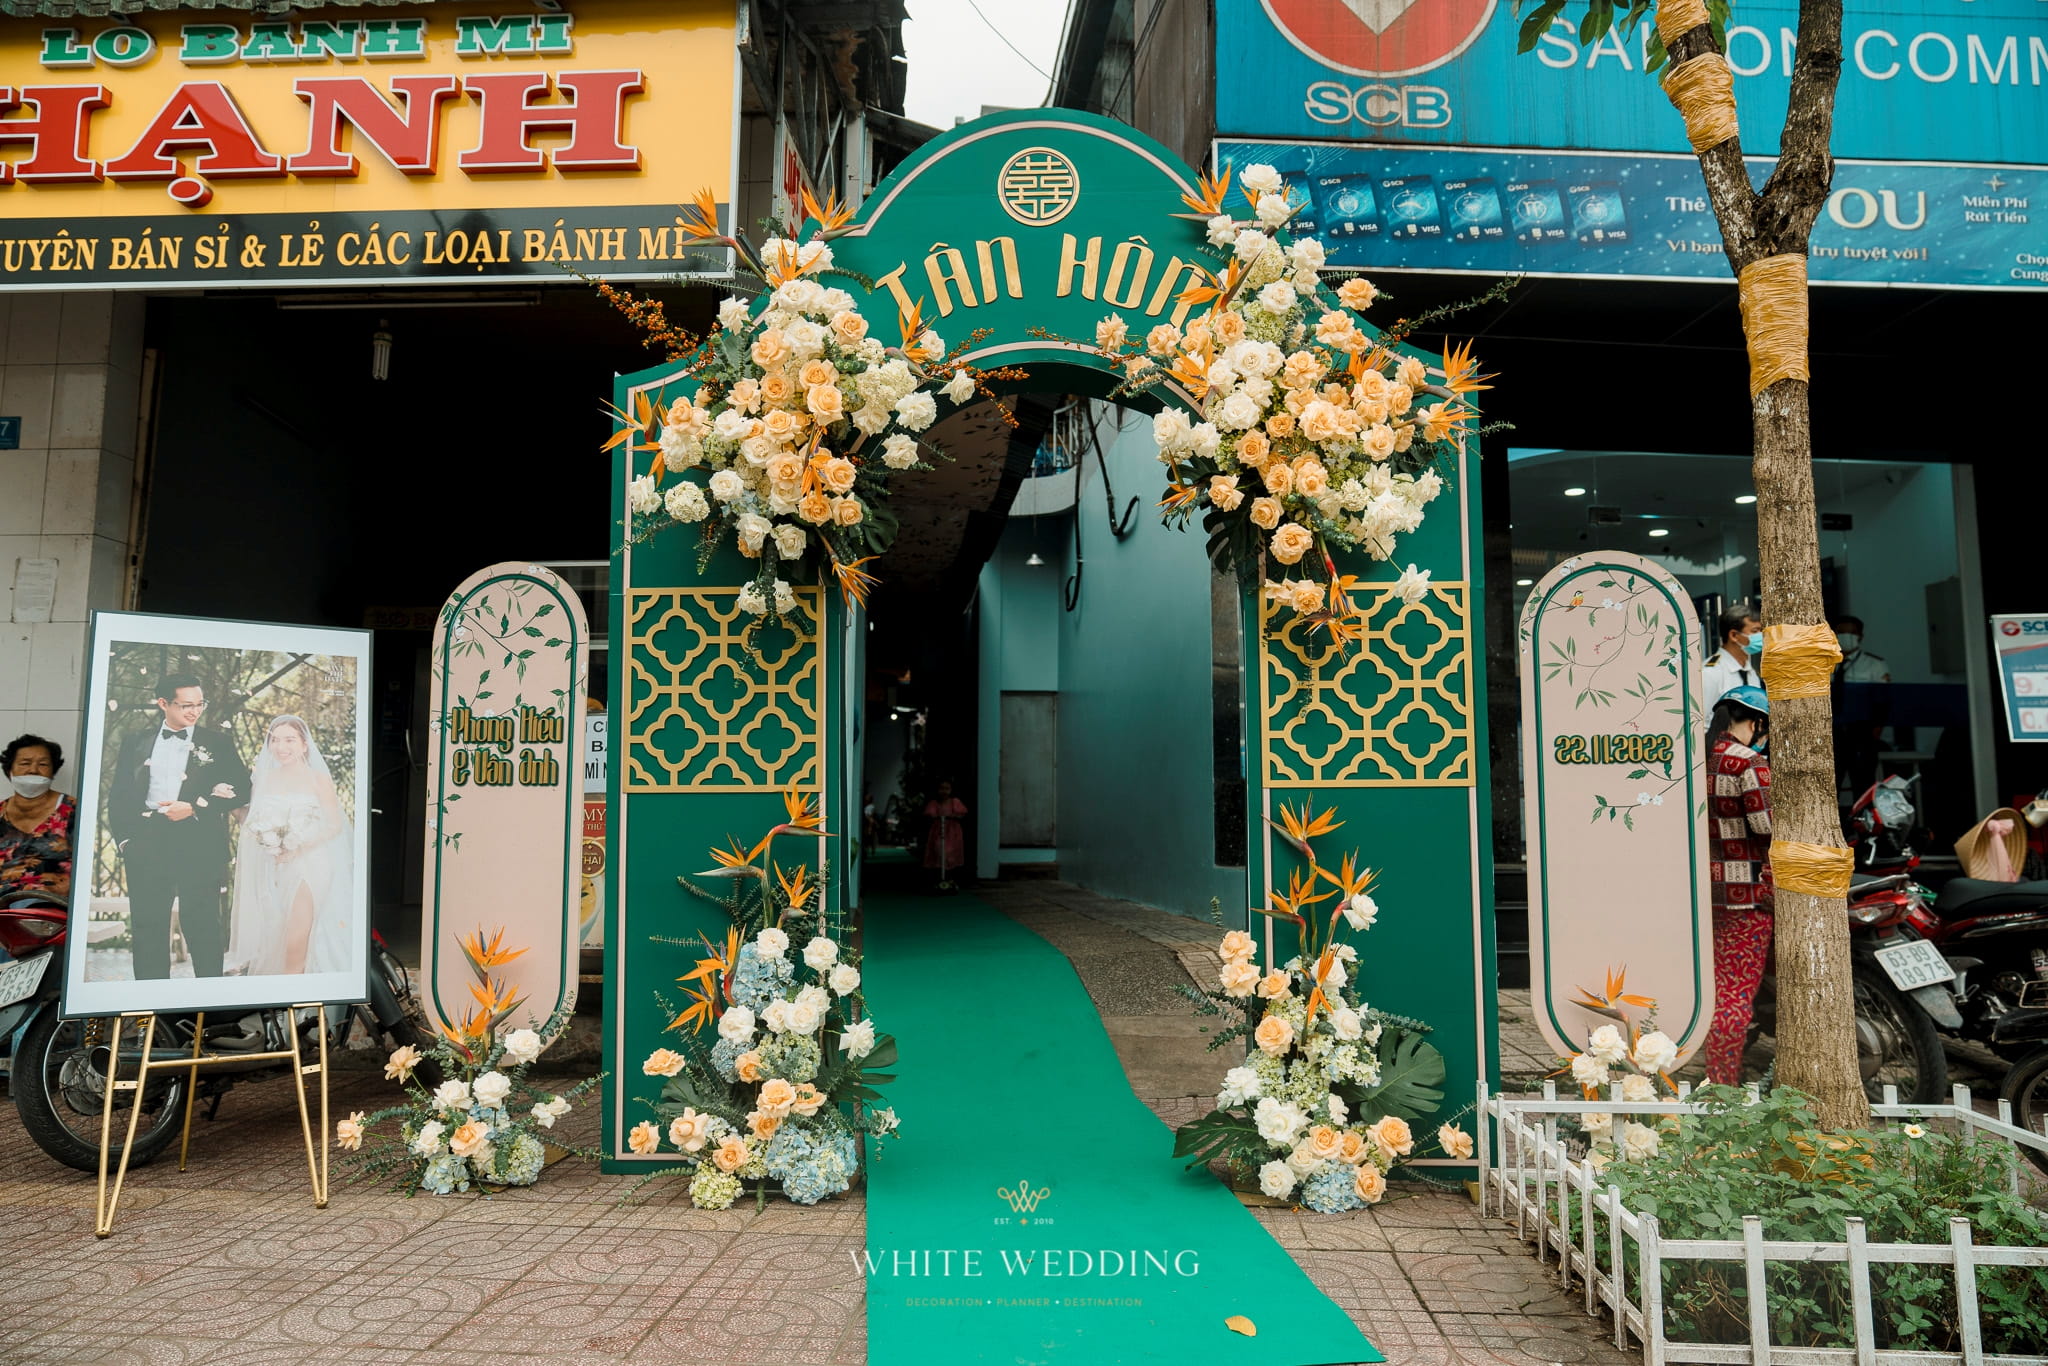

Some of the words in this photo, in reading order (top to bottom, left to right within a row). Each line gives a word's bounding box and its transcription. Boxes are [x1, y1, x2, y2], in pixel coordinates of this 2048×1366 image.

[1304, 81, 1452, 128] SCB
[1827, 187, 1926, 230] OU
[0, 229, 99, 272] UYÊN
[108, 227, 184, 270] BÁN
[193, 222, 230, 269] SỈ
[240, 234, 267, 269] &
[278, 220, 325, 267] LẺ
[337, 222, 411, 266] CÁC
[422, 229, 513, 272] LOẠI
[521, 218, 628, 262] BÁNH
[2022, 620, 2048, 633] SC
[451, 706, 514, 754] Phong
